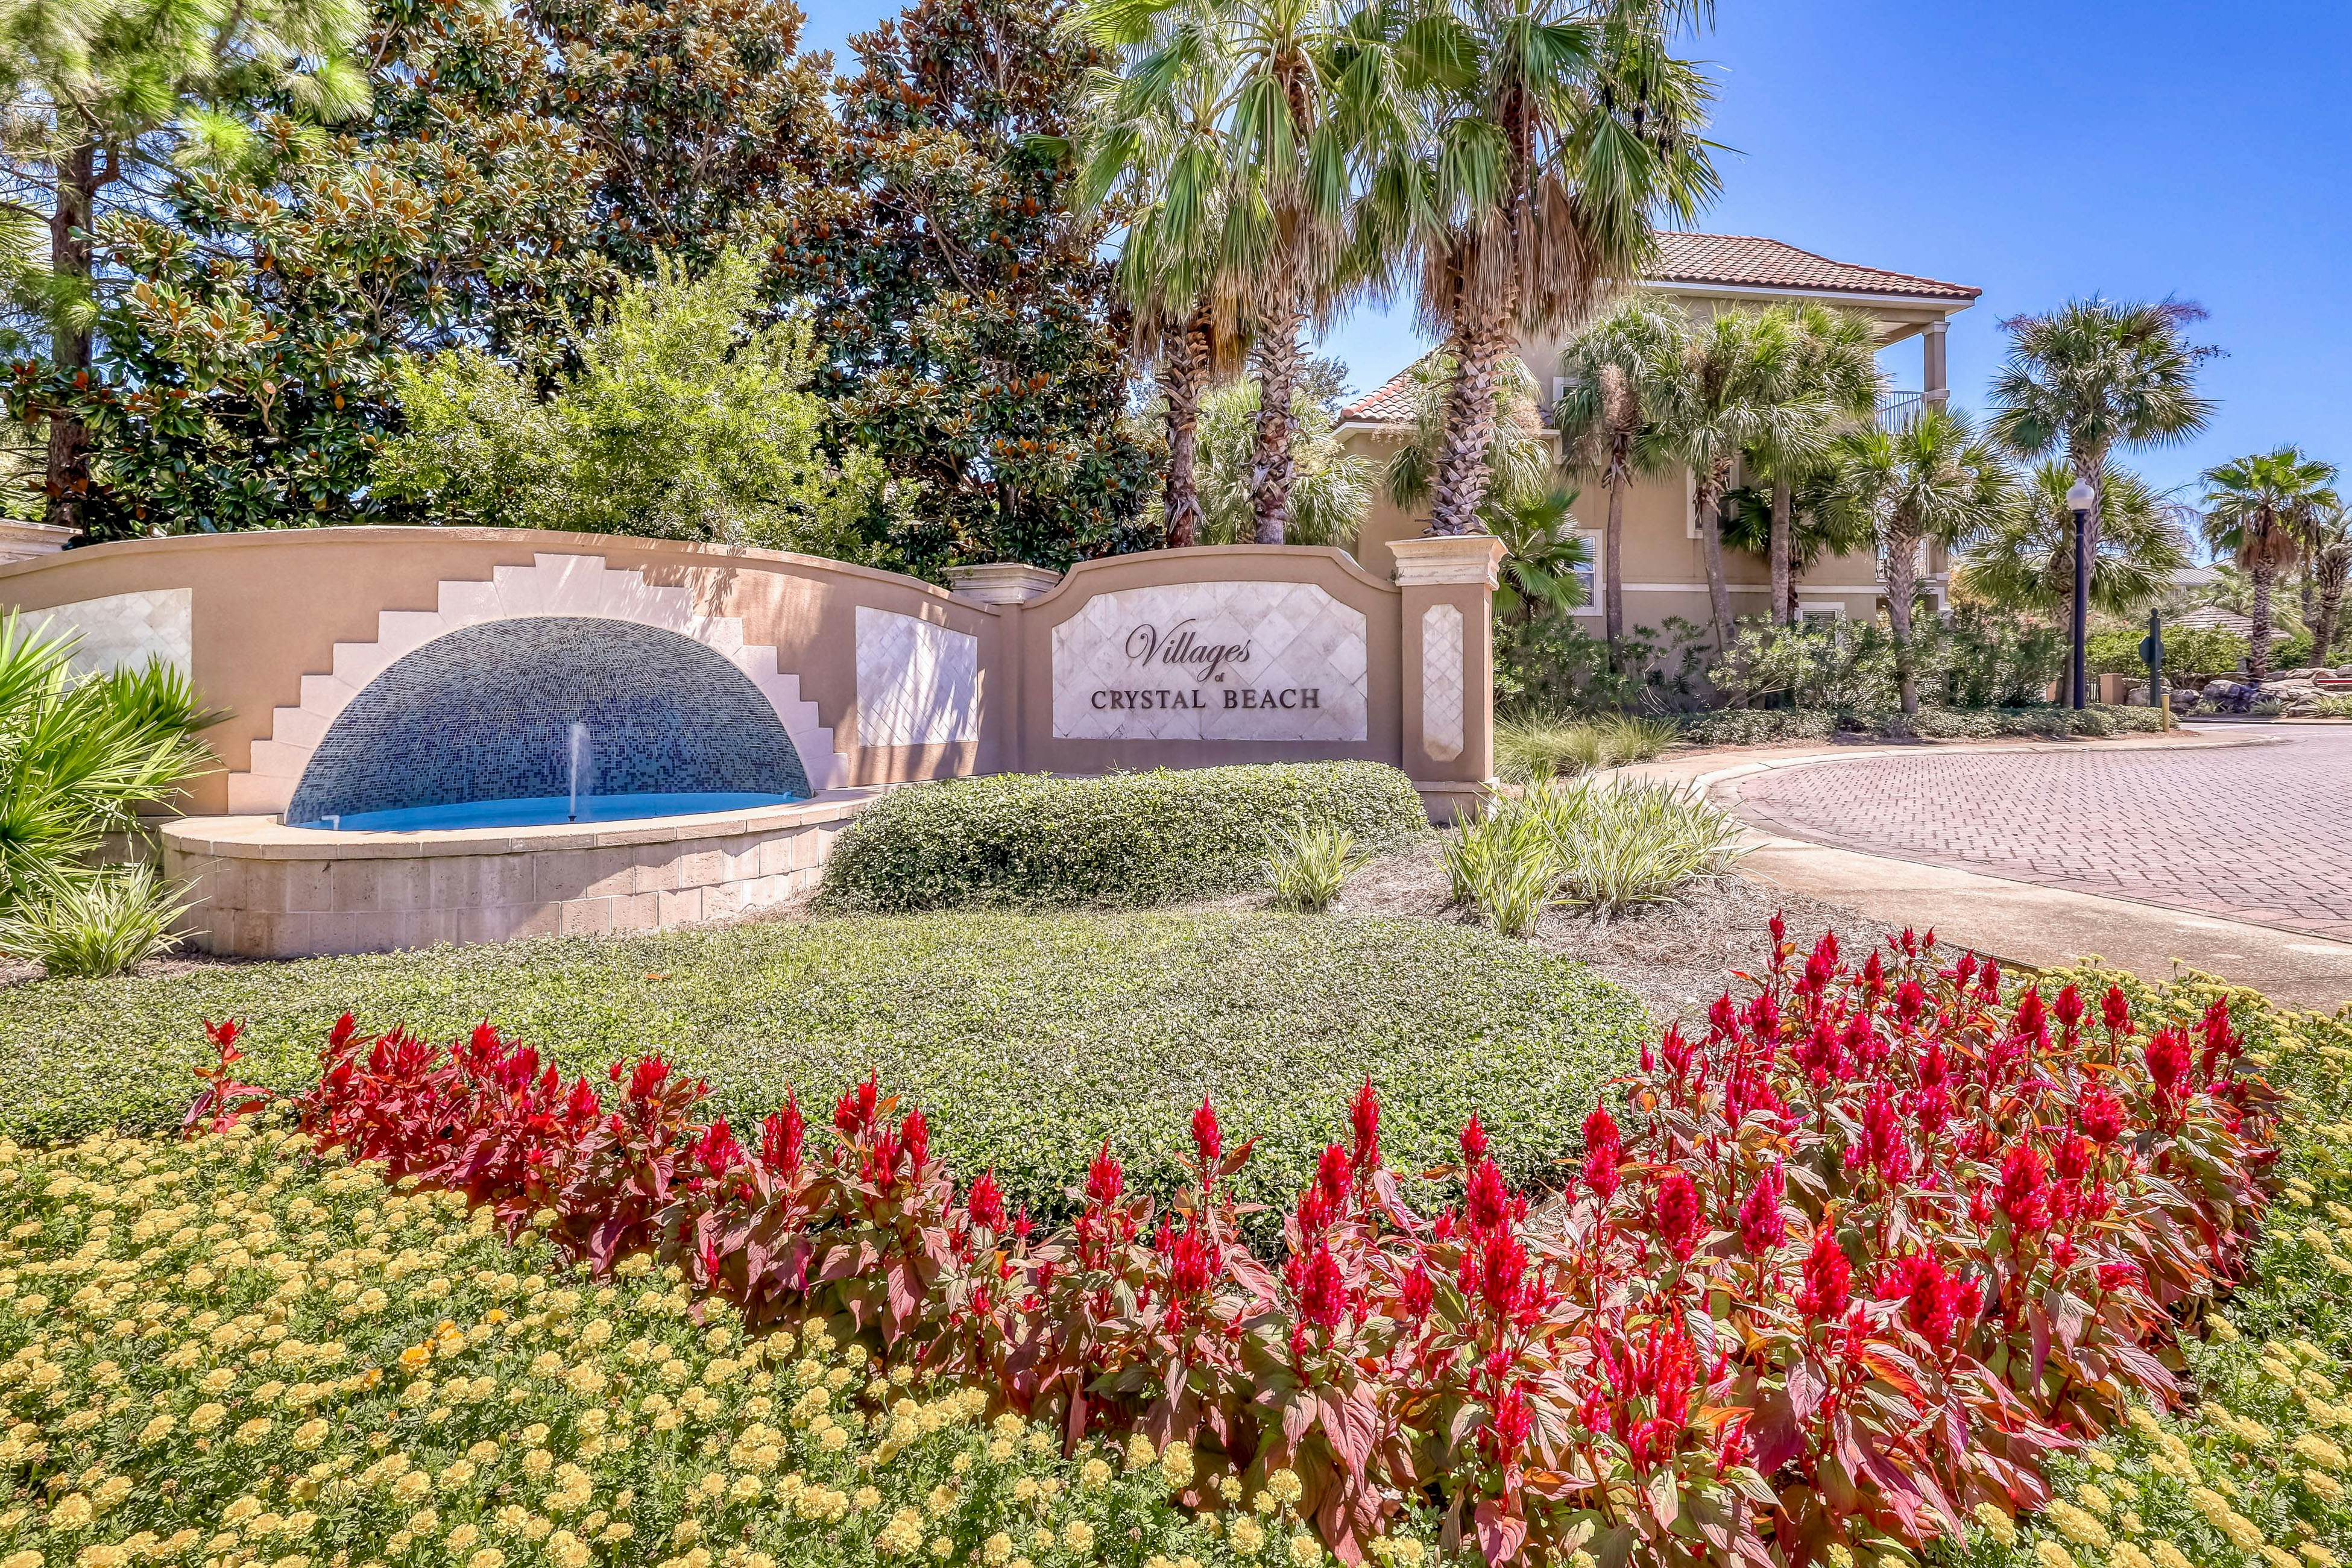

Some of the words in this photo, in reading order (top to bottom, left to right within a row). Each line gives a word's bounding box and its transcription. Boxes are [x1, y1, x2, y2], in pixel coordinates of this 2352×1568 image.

[1125, 619, 1250, 682] Villages
[1214, 672, 1225, 682] of
[1091, 689, 1206, 709] CRYSTAL
[1223, 688, 1320, 708] BEACH
